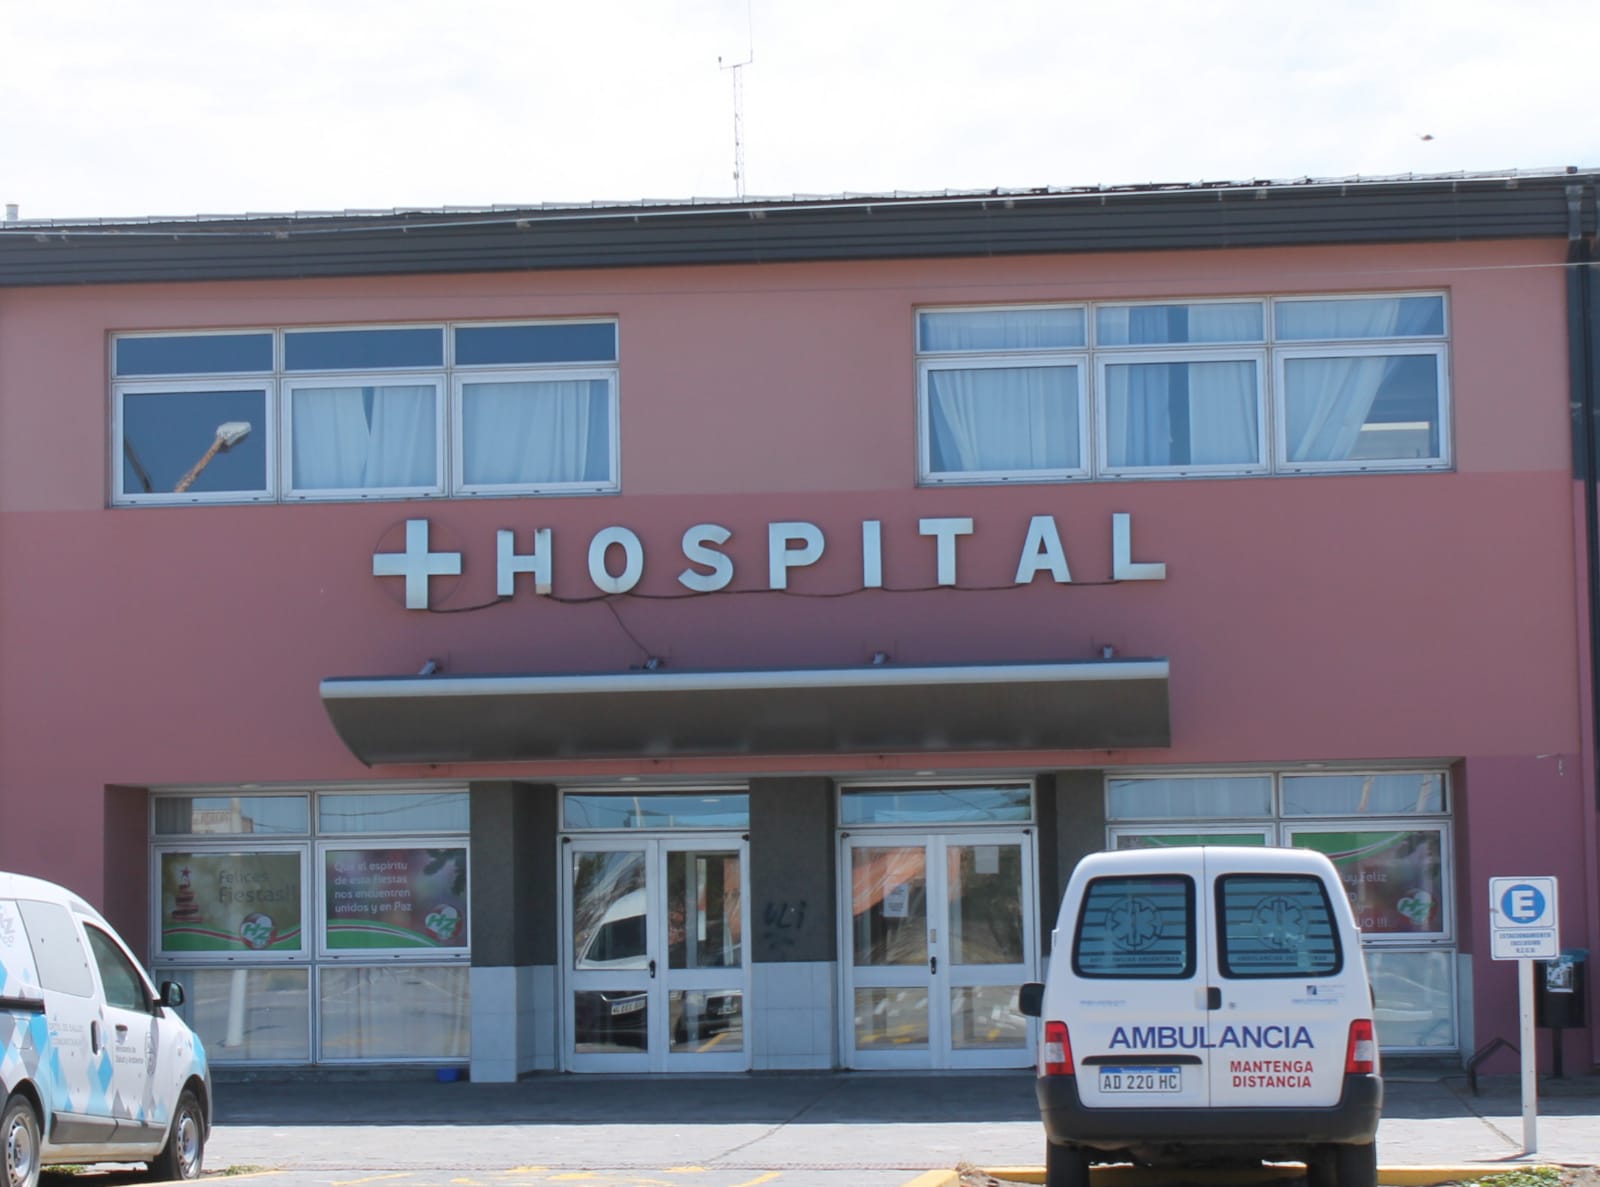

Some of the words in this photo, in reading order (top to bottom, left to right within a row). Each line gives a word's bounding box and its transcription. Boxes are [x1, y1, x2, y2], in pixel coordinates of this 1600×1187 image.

[497, 513, 1166, 596] HOSPITAL
[335, 890, 353, 900] nos
[355, 888, 411, 899] encuentren
[335, 903, 369, 913] unidos
[371, 903, 378, 914] y
[379, 903, 392, 912] en
[1511, 890, 1536, 917] E
[1108, 1025, 1315, 1049] AMBULANCIA
[1229, 1060, 1314, 1073] MANTENGA
[1103, 1074, 1122, 1090] AD
[1126, 1074, 1154, 1090] 220
[1158, 1074, 1177, 1090] HC
[1232, 1075, 1312, 1088] DISTANCIA
